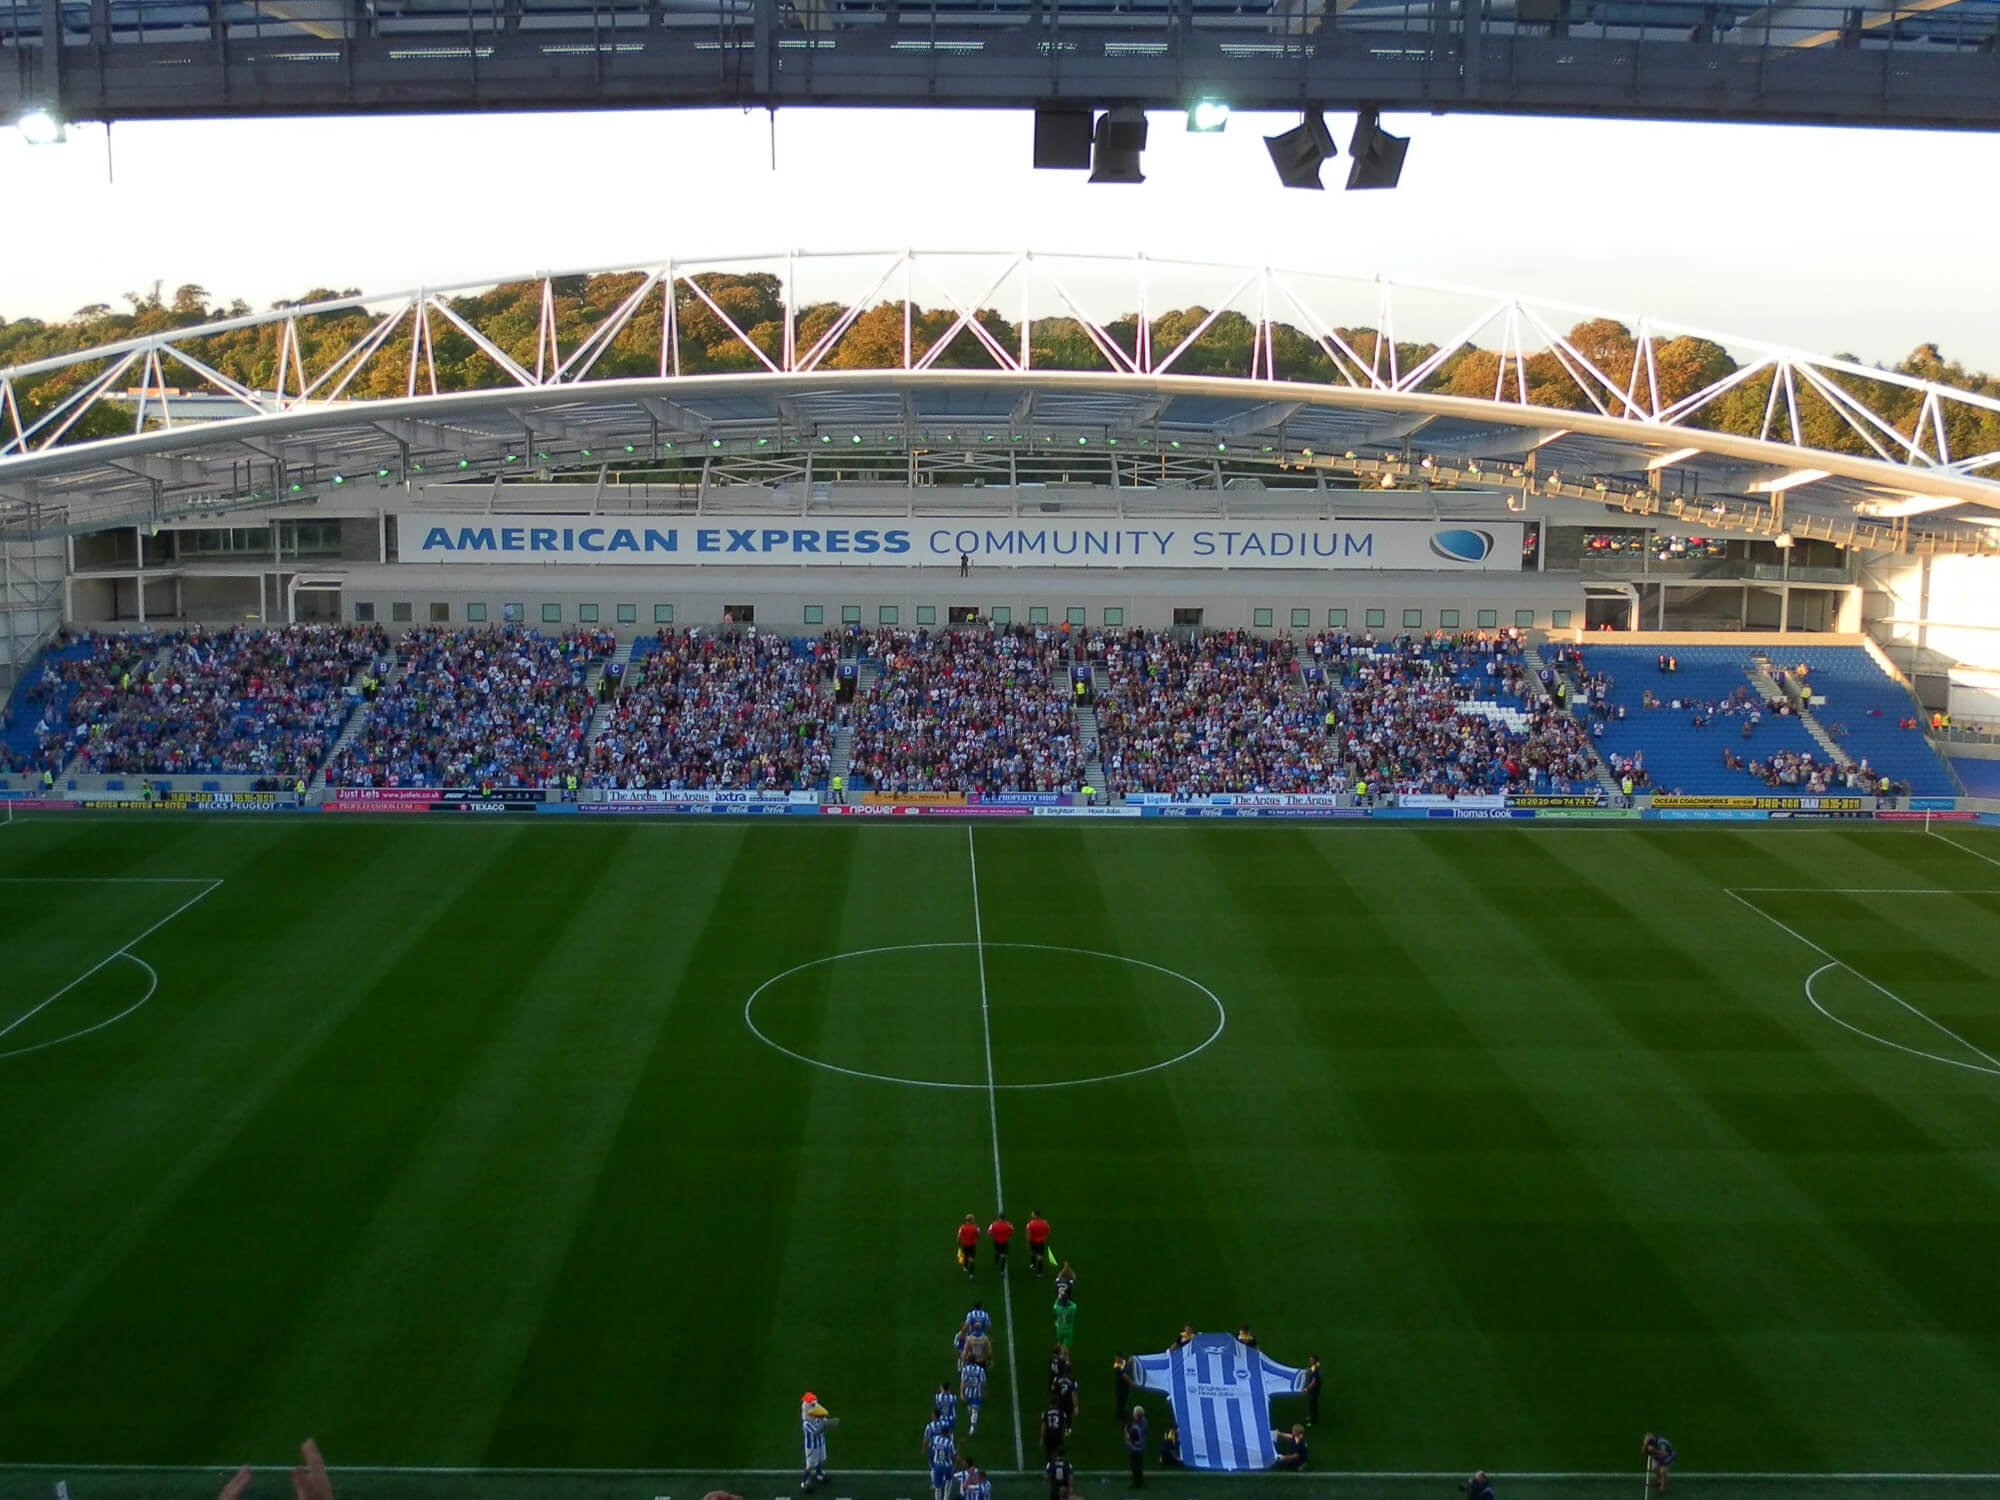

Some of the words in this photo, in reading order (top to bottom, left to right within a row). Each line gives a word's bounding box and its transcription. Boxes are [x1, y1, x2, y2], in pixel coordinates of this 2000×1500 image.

[422, 528, 678, 552] AMERICAN
[697, 529, 911, 554] EXPRESS
[929, 530, 1176, 556] COMMUNITY
[1193, 530, 1373, 558] STADIUM
[380, 662, 388, 672] B
[612, 664, 619, 673] C
[844, 666, 852, 675] D
[1077, 667, 1084, 677] E
[1309, 669, 1316, 678] F
[1541, 670, 1548, 679] G
[214, 792, 233, 802] TAXI
[340, 789, 358, 798] Just
[361, 789, 380, 798] Lets
[610, 791, 625, 800] The
[629, 791, 657, 802] Argus
[662, 791, 679, 801] The
[683, 791, 710, 802] Argus
[715, 791, 746, 802] axtra
[1232, 795, 1249, 804] The
[1253, 795, 1281, 806] Argus
[1284, 795, 1301, 805] The
[1304, 795, 1332, 806] Argus
[1800, 798, 1820, 808] TAXI
[198, 802, 228, 810] BECKS
[230, 802, 276, 810] PEUGEOT
[469, 803, 505, 811] TEXACO
[849, 804, 897, 815] npower
[1047, 807, 1076, 815] Brighton
[1452, 808, 1488, 818] Thomas
[1489, 808, 1512, 818] Cook
